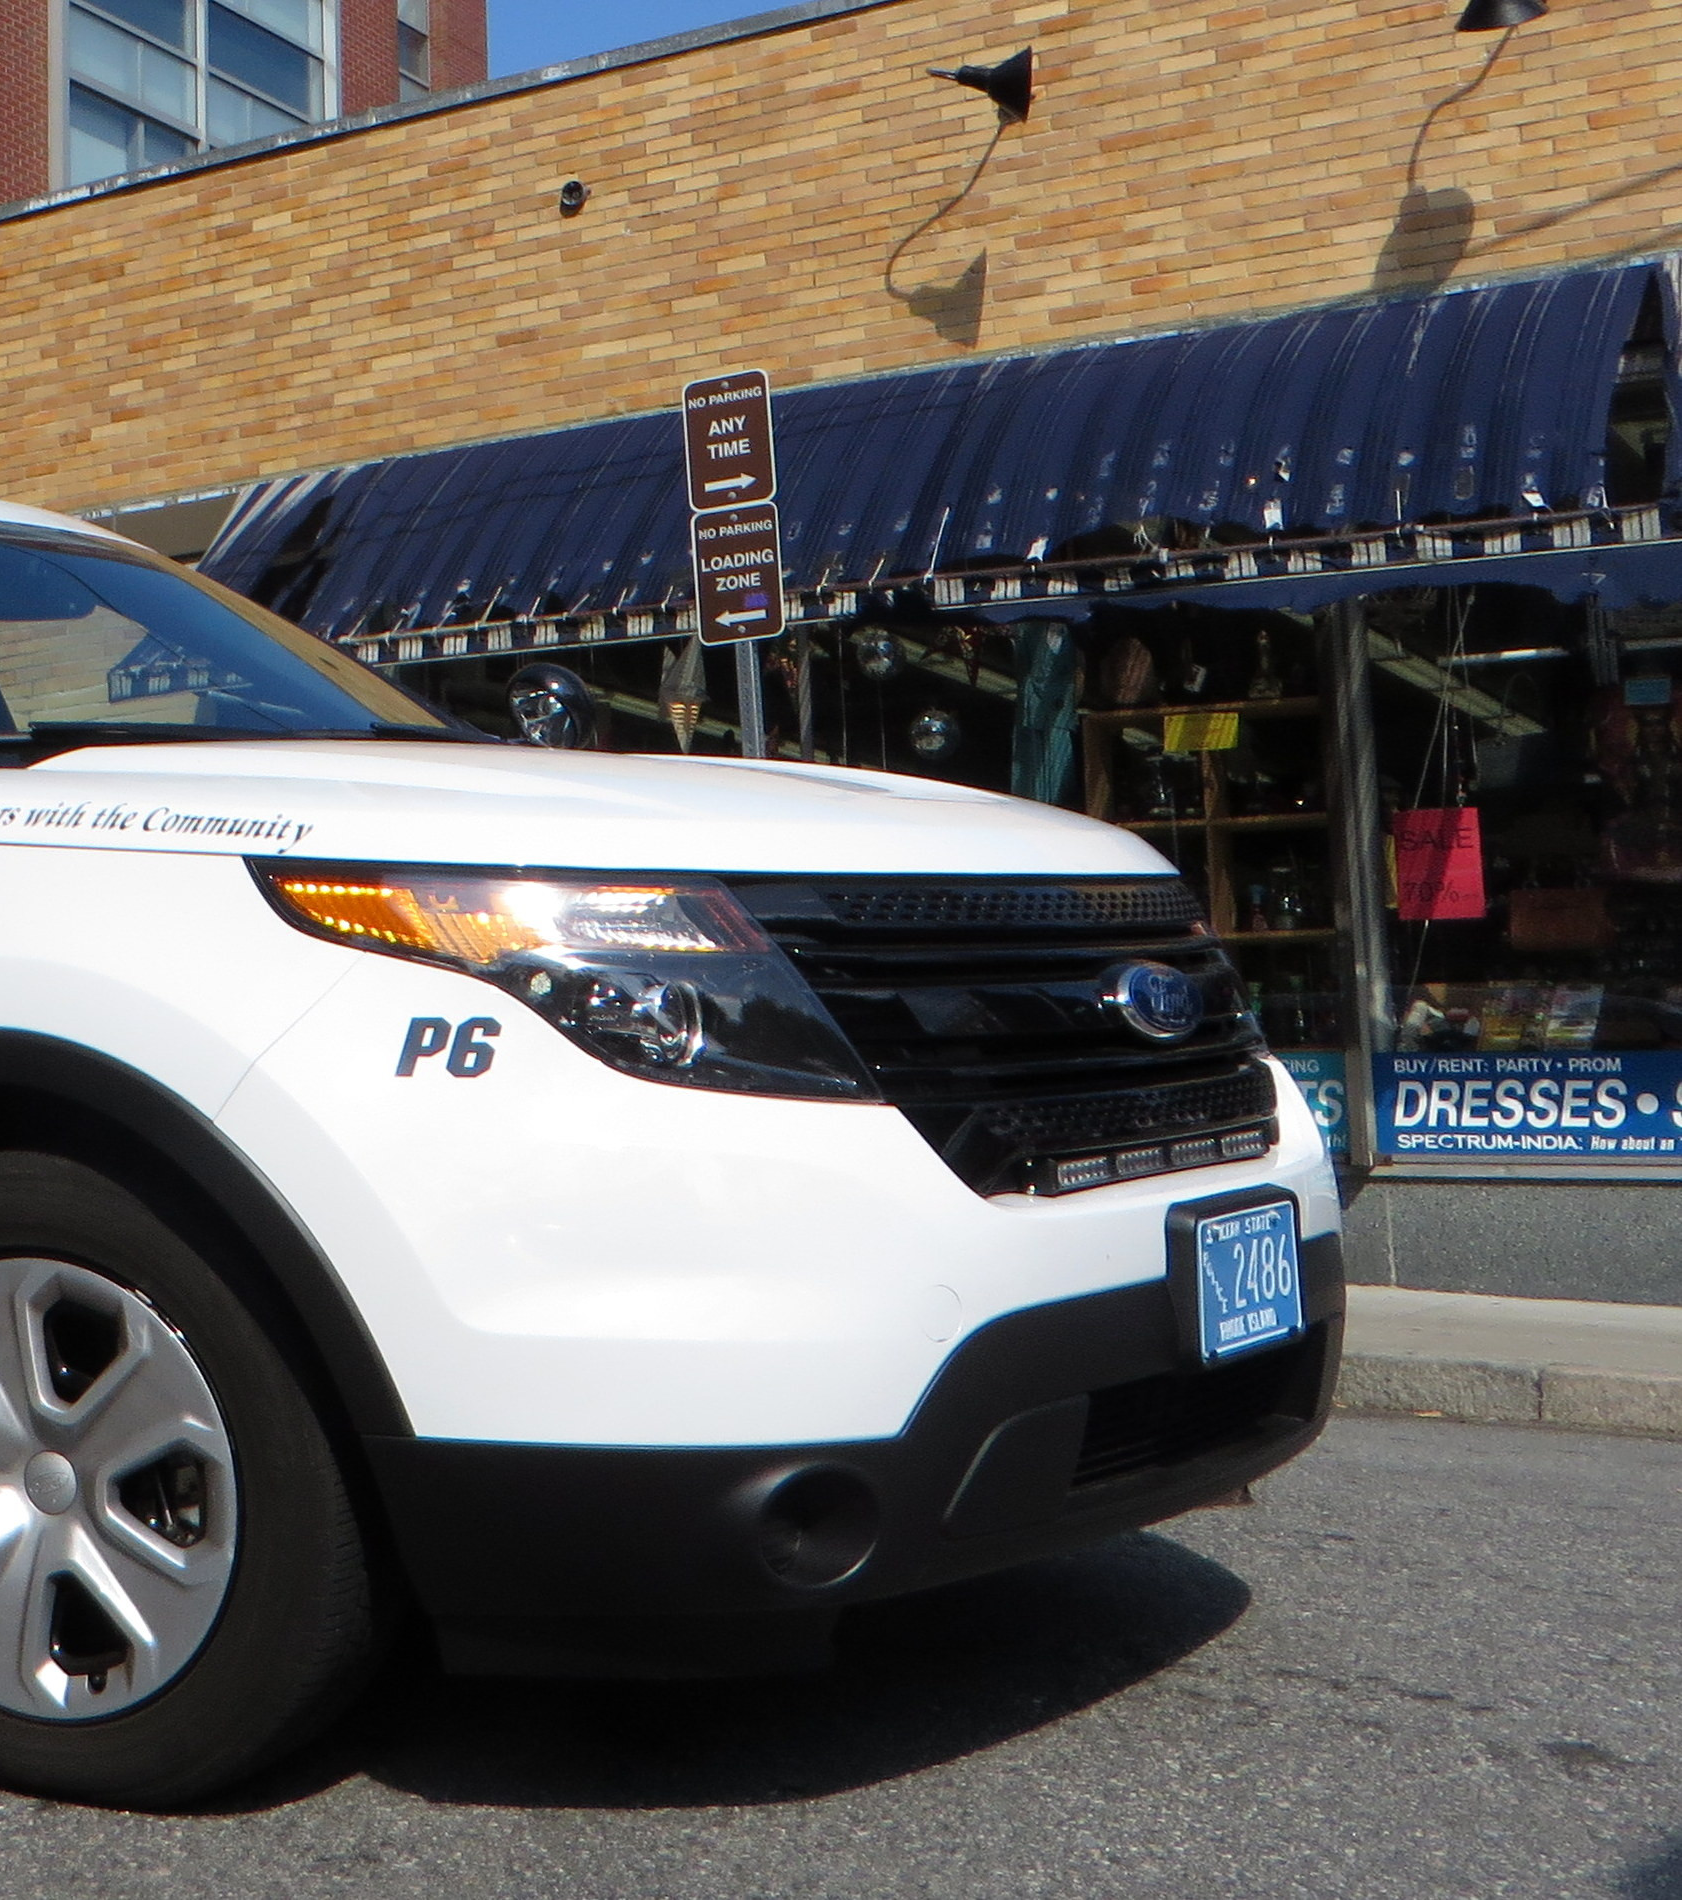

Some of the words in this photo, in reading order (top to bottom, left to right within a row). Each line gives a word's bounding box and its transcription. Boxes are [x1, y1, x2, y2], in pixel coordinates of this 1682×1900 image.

[688, 397, 706, 409] NO
[708, 385, 763, 405] PARKING
[708, 415, 746, 437] ANY
[706, 438, 751, 460] TIME
[698, 528, 716, 540] NO
[718, 519, 773, 537] PARKING
[700, 548, 775, 573] LOADING
[715, 571, 761, 592] ZONE
[23, 801, 93, 829] with
[92, 802, 138, 831] the
[142, 806, 314, 855] Community
[1398, 826, 1475, 850] SALE
[395, 1017, 502, 1077] P6
[1394, 1057, 1489, 1073] BUY/RENT:
[1496, 1057, 1553, 1073] PARTY
[1568, 1057, 1622, 1073] PROM
[1394, 1078, 1628, 1129] DRESSES
[1591, 1135, 1617, 1151] How
[1621, 1135, 1656, 1151] about
[1659, 1138, 1675, 1151] an
[1233, 1234, 1292, 1309] 2486
